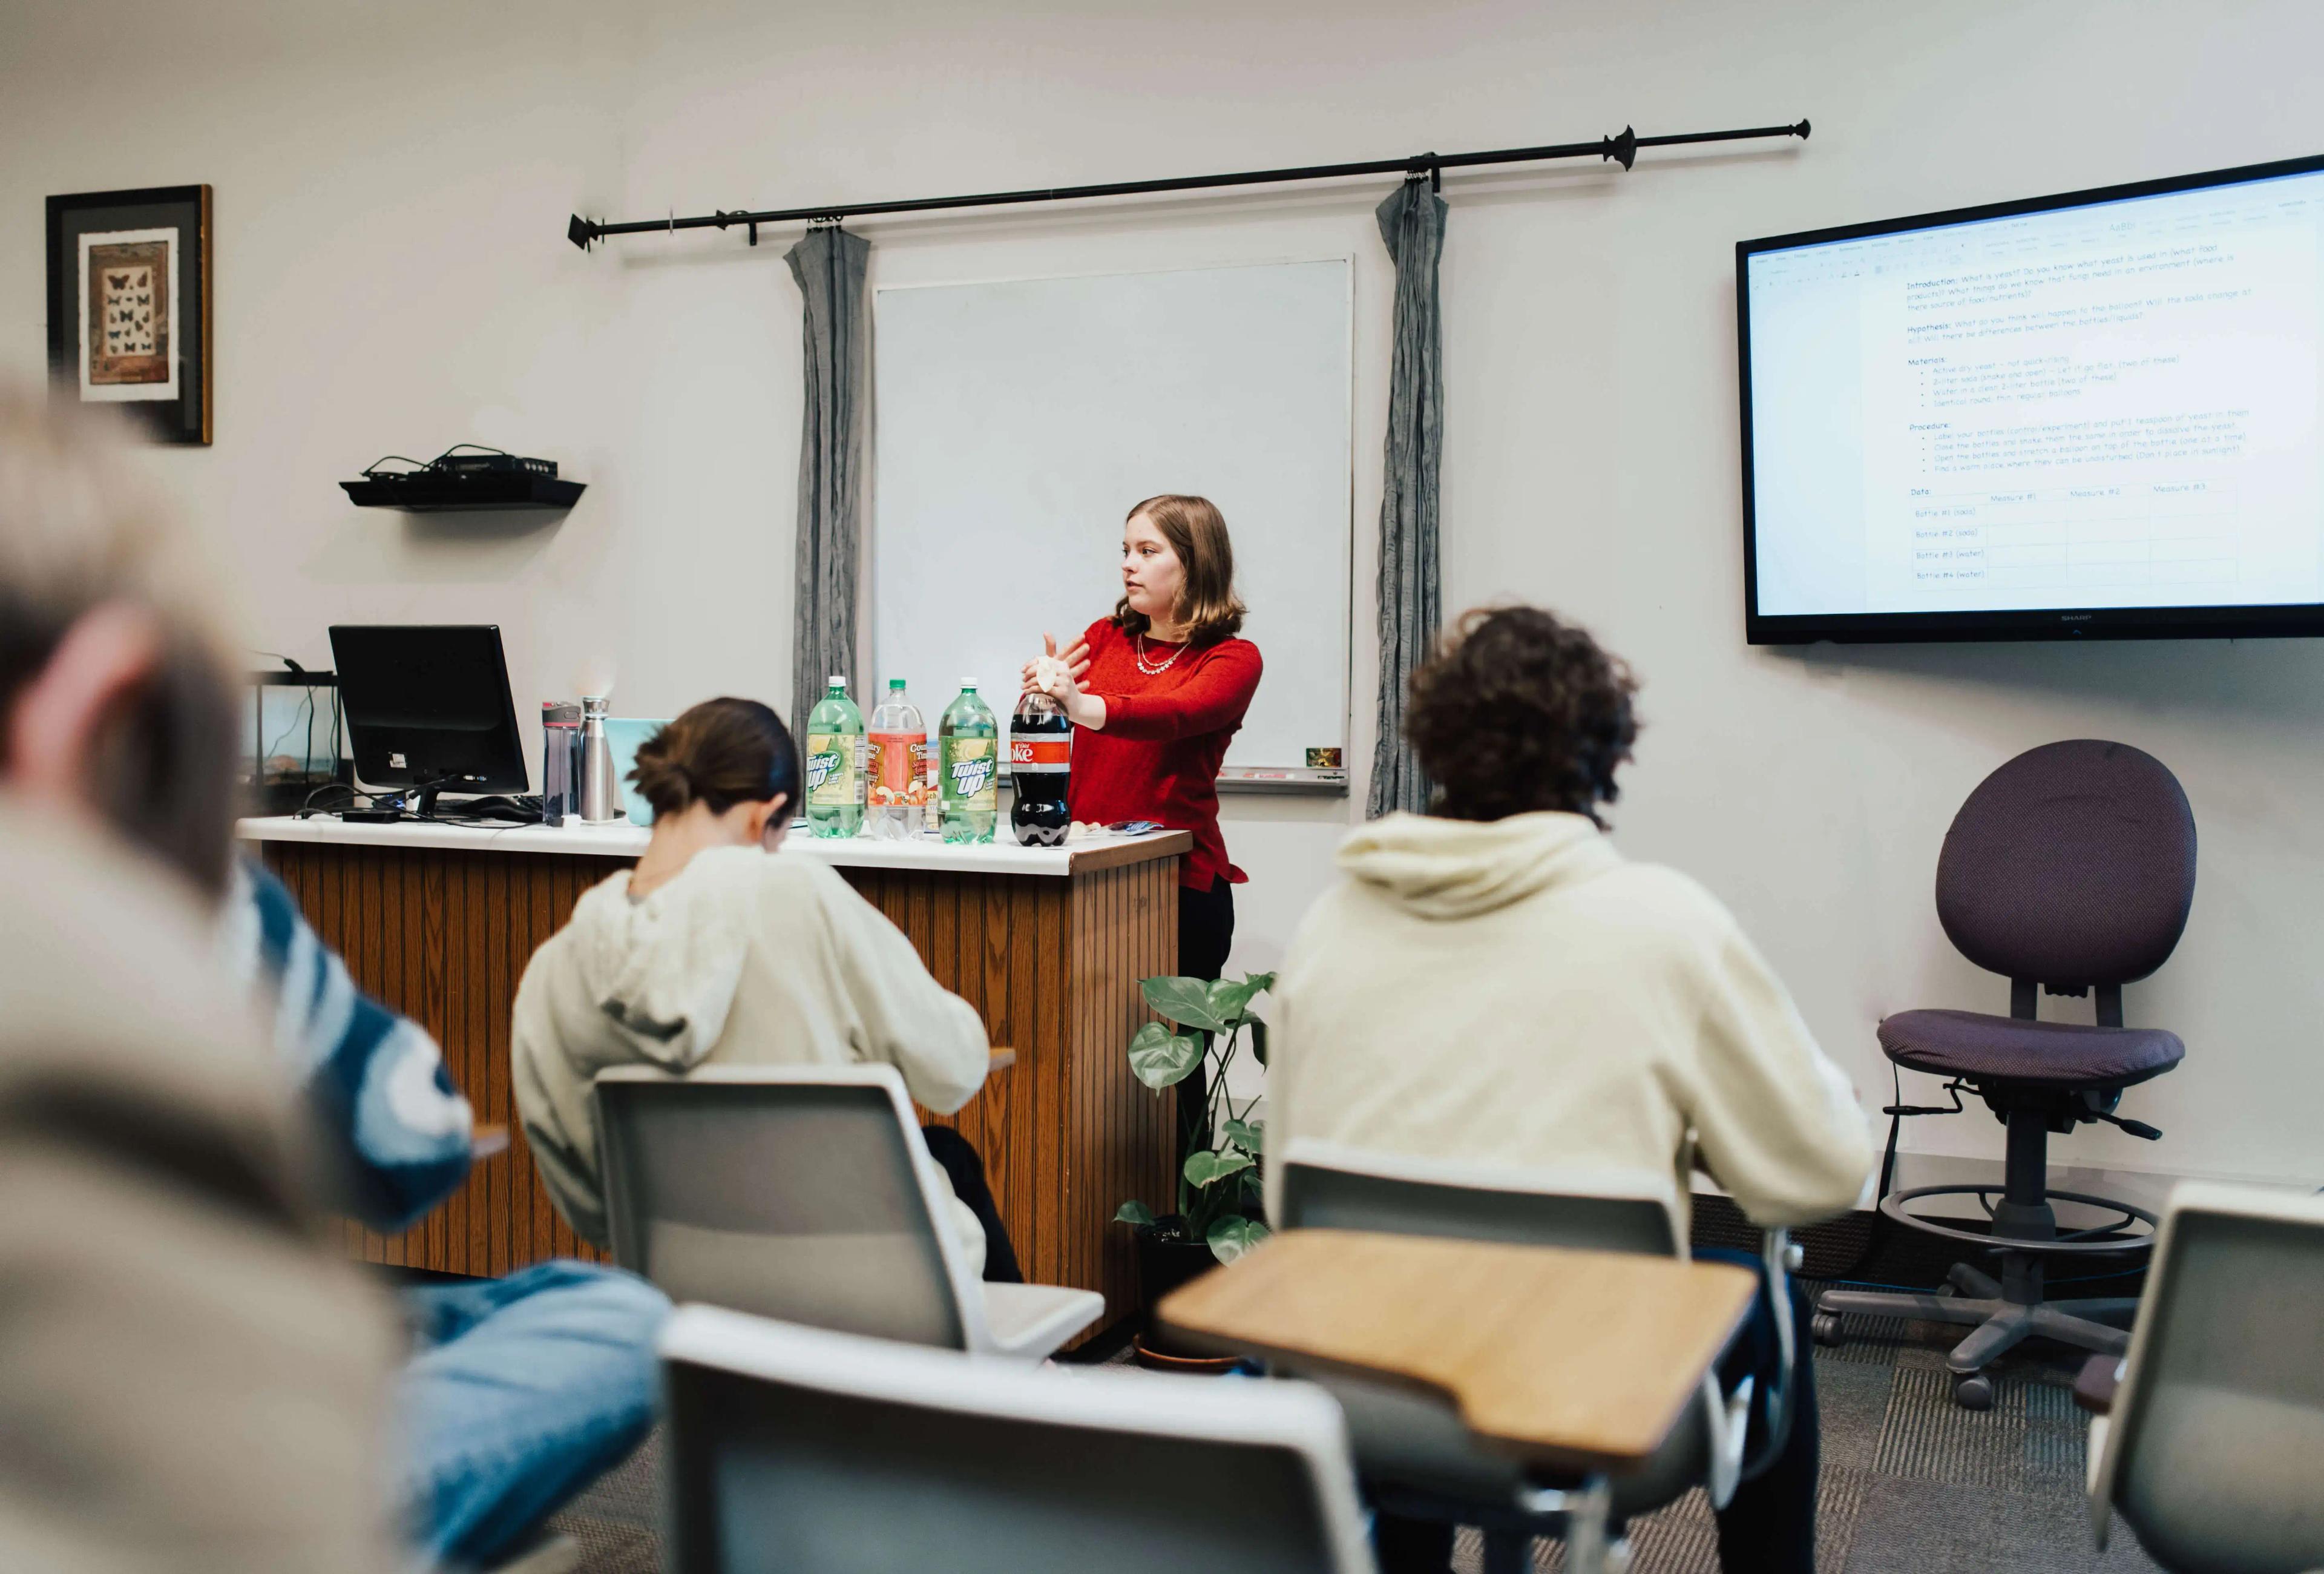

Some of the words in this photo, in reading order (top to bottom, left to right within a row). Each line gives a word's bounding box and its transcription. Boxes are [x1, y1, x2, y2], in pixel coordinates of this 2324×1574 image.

[1907, 278, 1957, 290] Introduction:
[1907, 323, 1951, 335] Hypothesis:
[1908, 357, 1947, 366] Materials:
[1909, 423, 1951, 432] Procedure:
[2153, 484, 2190, 493] Measure
[2193, 483, 2207, 492] #3
[1990, 493, 2024, 502] Measure
[2070, 490, 2105, 498] Measure
[1953, 507, 1976, 517] (soda)
[1955, 528, 1978, 538] (soda)
[1955, 550, 1985, 559] (water)
[1956, 570, 1984, 579] (water)
[809, 753, 839, 771] wist
[951, 757, 993, 779] Twist
